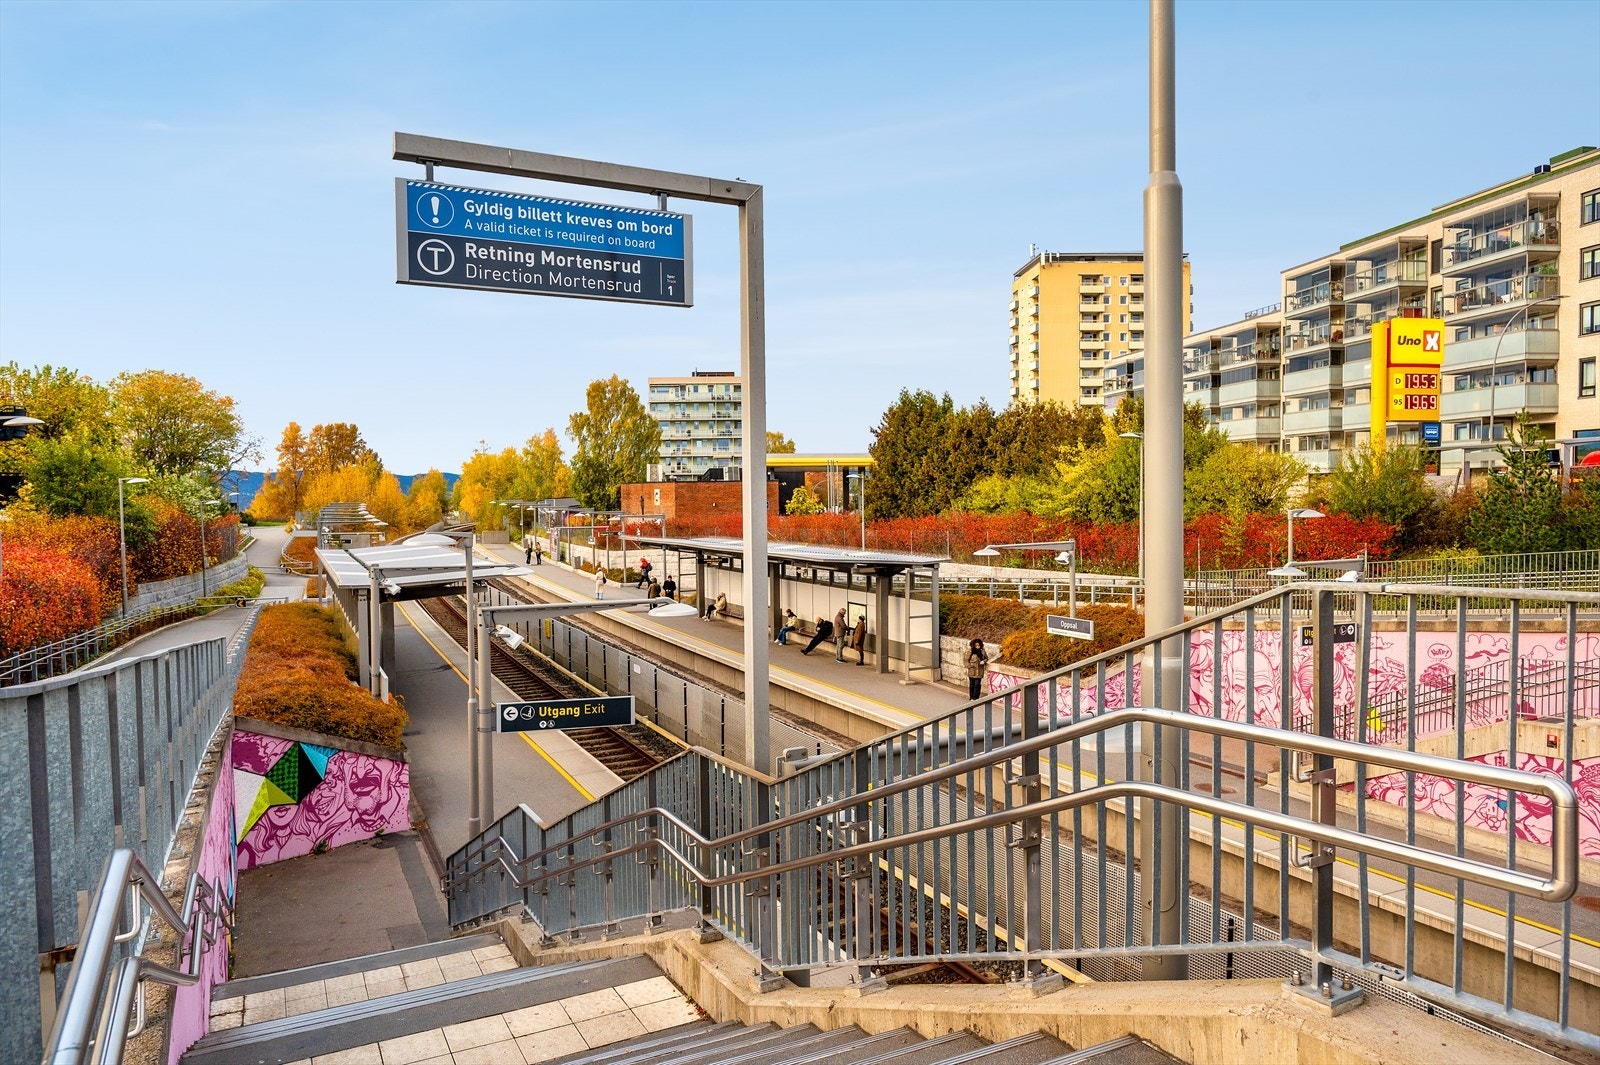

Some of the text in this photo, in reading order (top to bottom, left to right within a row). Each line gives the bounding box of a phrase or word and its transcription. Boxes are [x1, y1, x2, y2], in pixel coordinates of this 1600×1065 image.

[463, 199, 673, 236] Gyldig billett kreves om bord
[464, 219, 655, 250] A valid ticket is required on board
[426, 247, 446, 271] T
[465, 242, 641, 274] Retning Mortensrud
[466, 263, 641, 293] Direction Mortensrud
[667, 285, 673, 296] 1
[1398, 332, 1439, 350] Uno X
[1406, 374, 1437, 388] 19.53
[1393, 395, 1437, 409] 95 19.69
[1061, 620, 1078, 629] Oppsal
[538, 703, 605, 718] Utgang Exit
